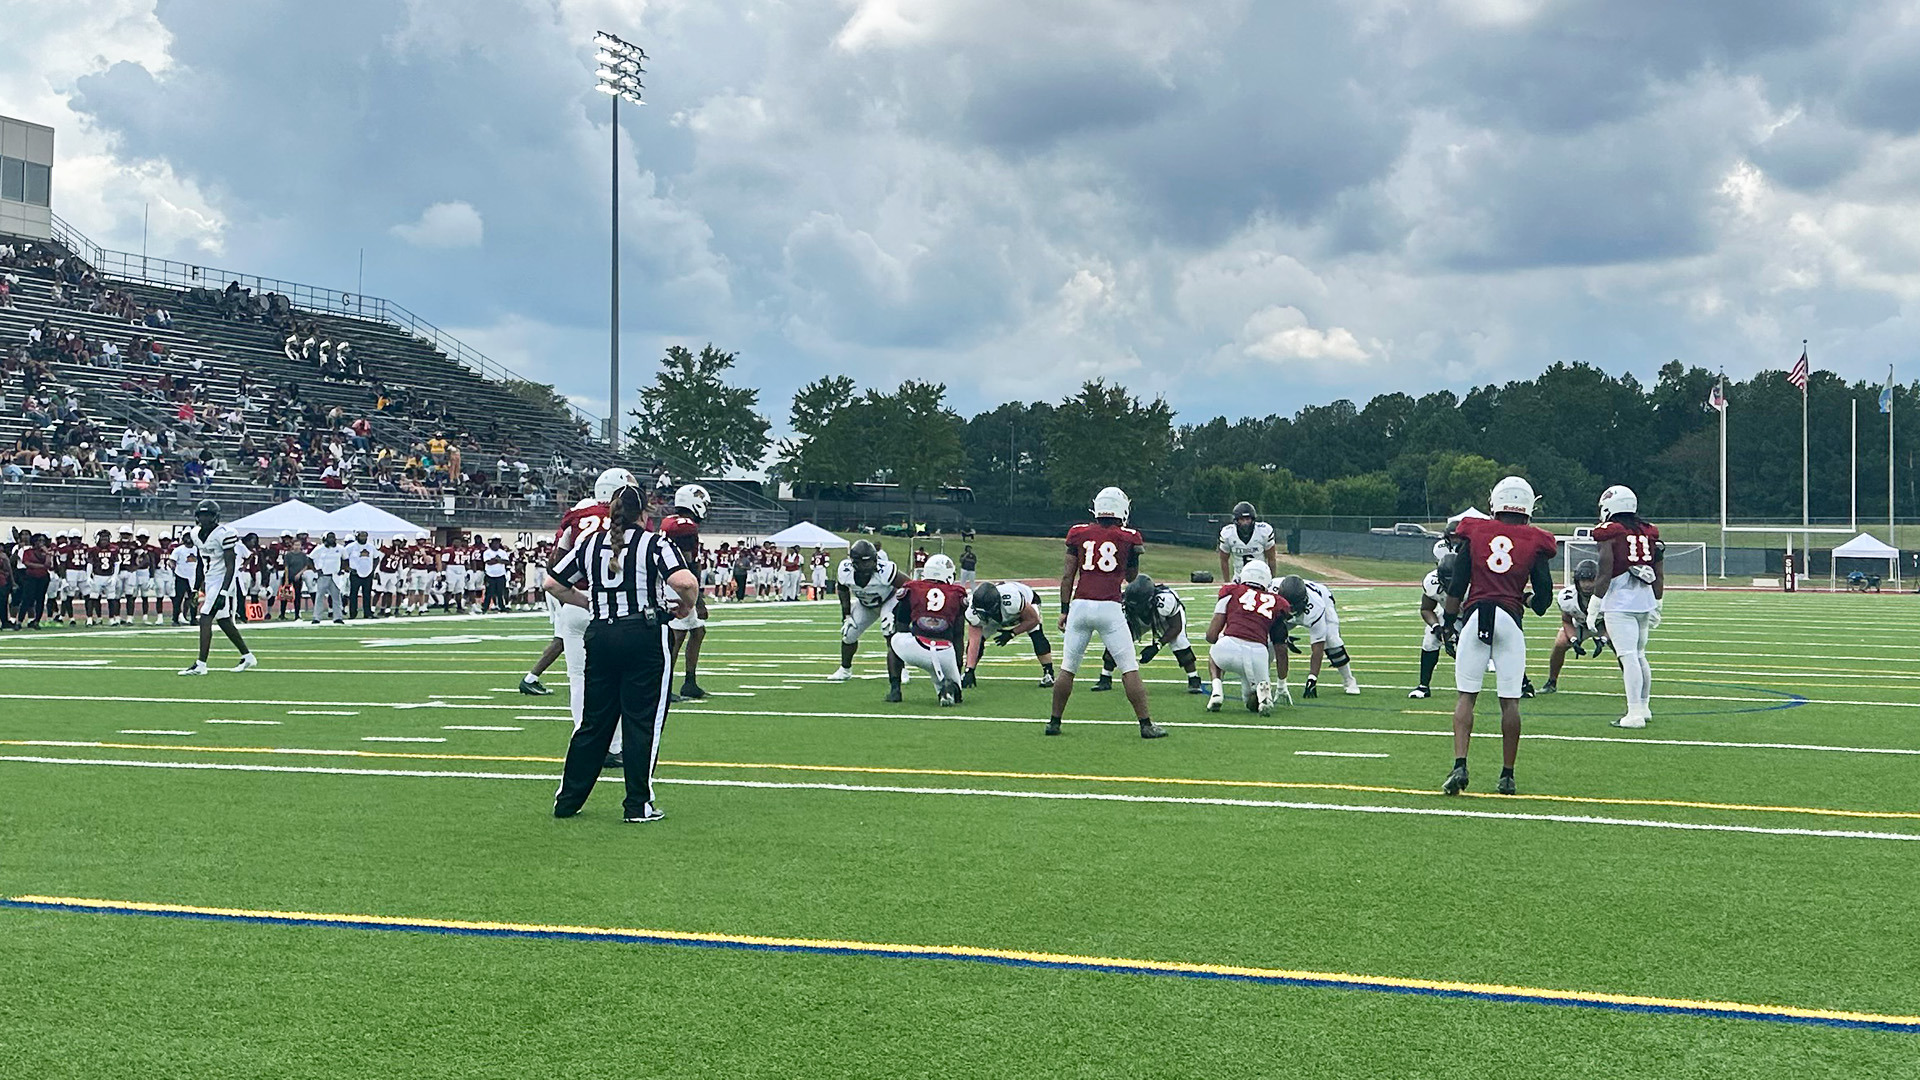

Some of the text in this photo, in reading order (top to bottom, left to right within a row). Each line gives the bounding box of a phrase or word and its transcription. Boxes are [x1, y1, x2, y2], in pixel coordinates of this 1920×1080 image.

[192, 266, 199, 281] F
[342, 293, 350, 306] G
[1082, 540, 1119, 573] 18
[1486, 535, 1514, 574] 8
[1626, 535, 1652, 562] 11
[600, 547, 628, 589] U
[249, 606, 263, 619] 30
[925, 587, 946, 612] 9
[1239, 588, 1277, 621] 42
